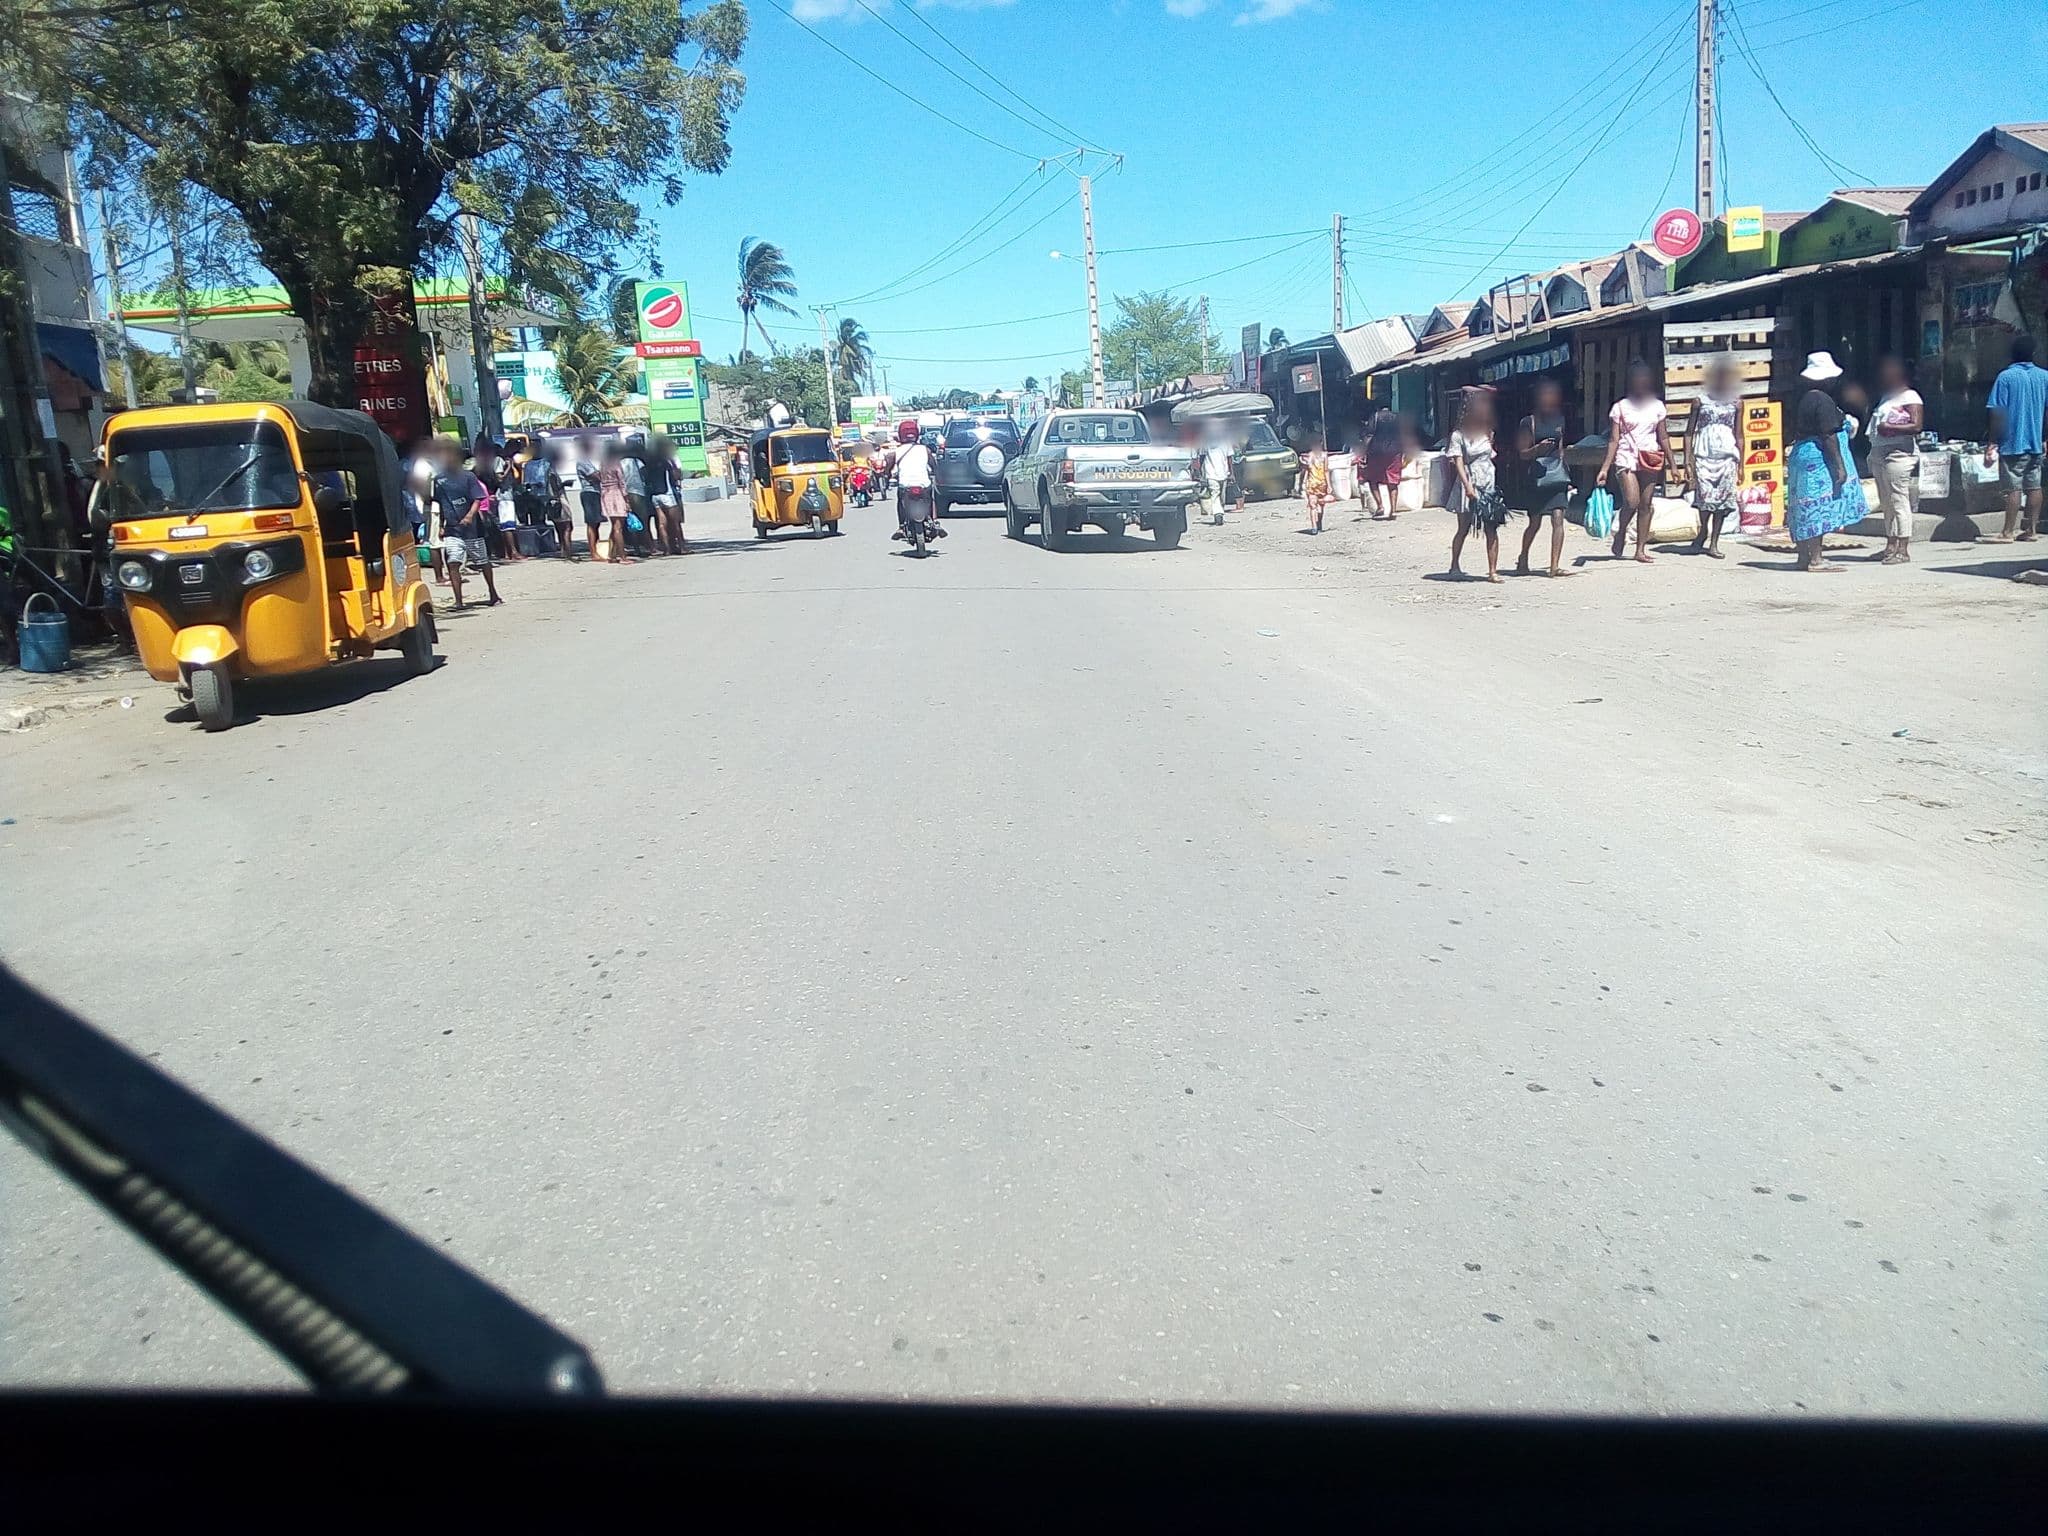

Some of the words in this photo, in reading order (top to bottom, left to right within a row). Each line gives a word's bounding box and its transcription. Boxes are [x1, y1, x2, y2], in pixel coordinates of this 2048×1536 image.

[1666, 222, 1689, 239] THB
[644, 344, 691, 354] Tsararano
[1094, 465, 1172, 480] MITSUBISHI
